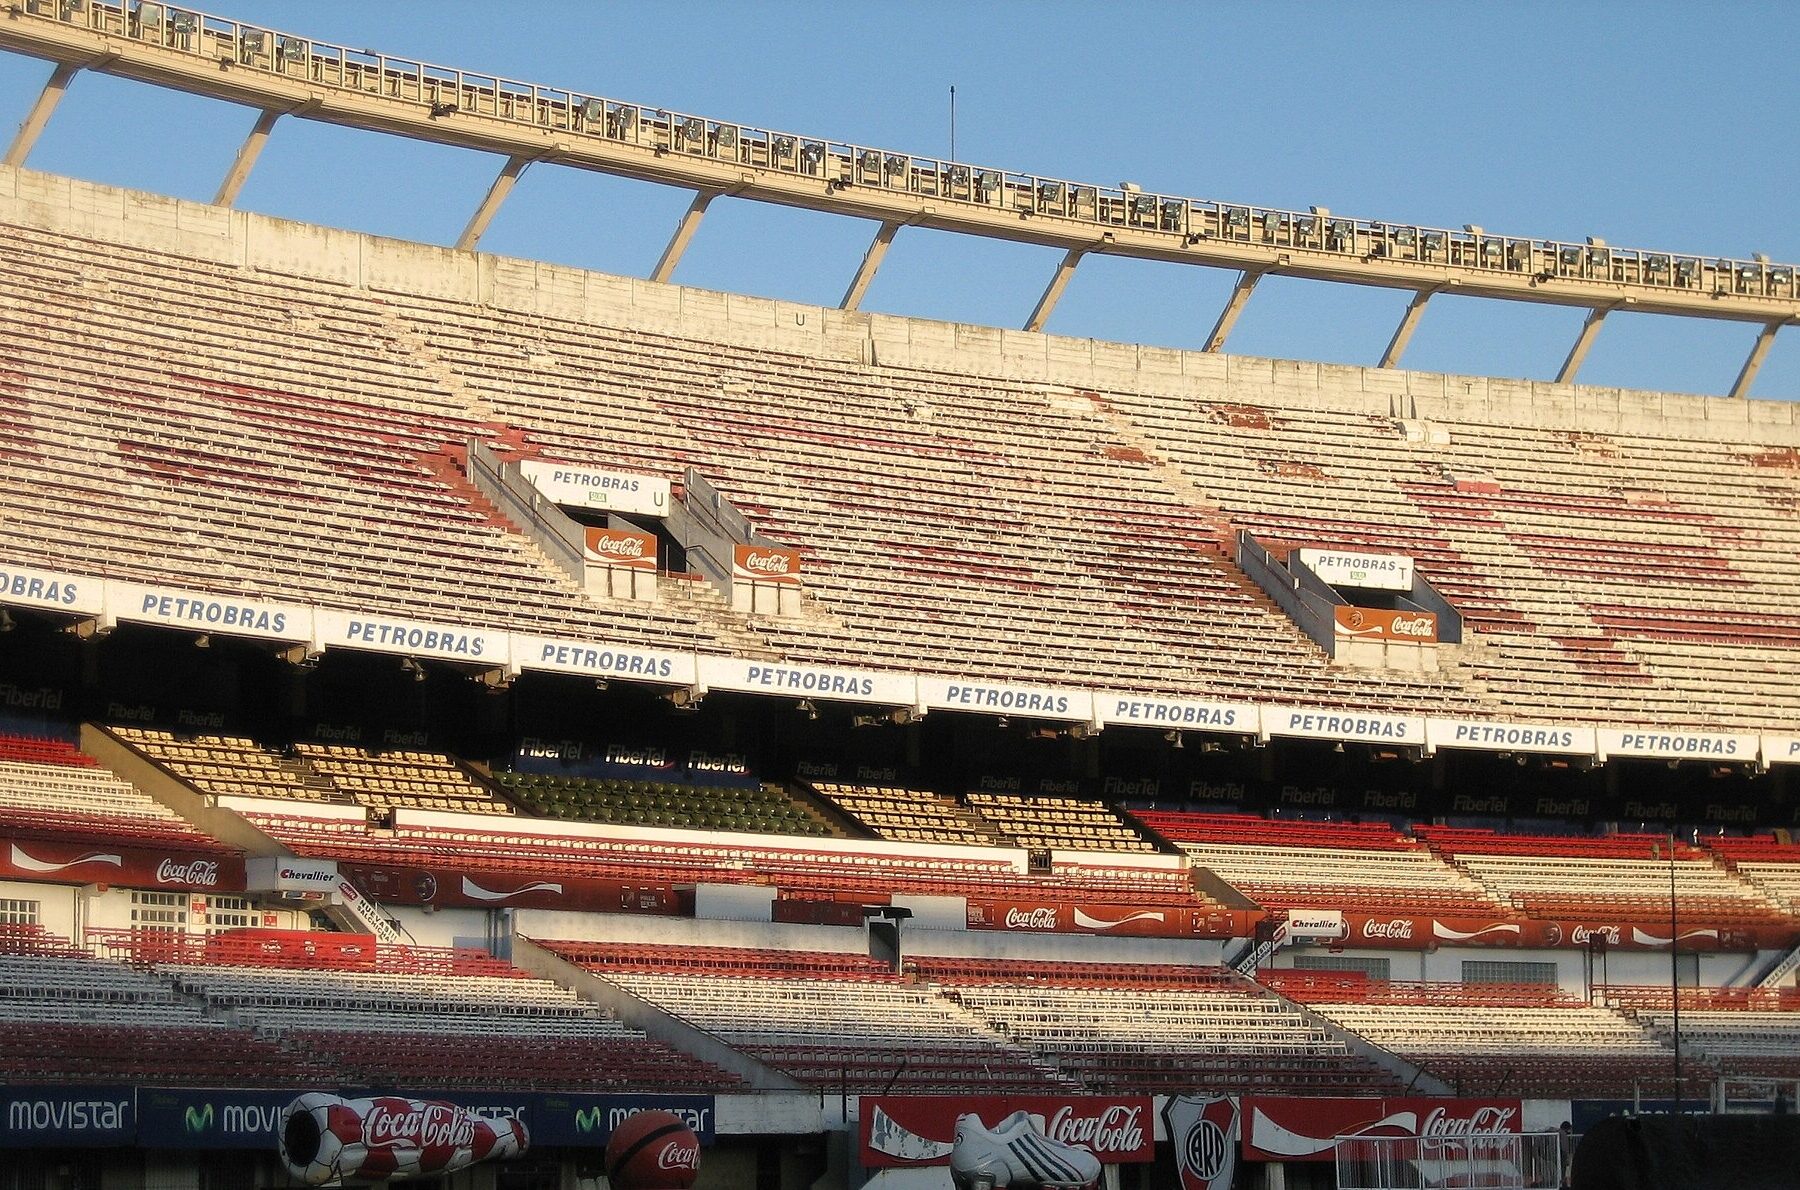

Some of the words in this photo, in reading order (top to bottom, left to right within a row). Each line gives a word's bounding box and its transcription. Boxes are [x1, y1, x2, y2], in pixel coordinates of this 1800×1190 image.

[795, 312, 805, 326] U
[553, 470, 640, 492] PETROBRAS
[653, 491, 664, 507] U
[597, 534, 645, 557] Coca-Cola
[745, 552, 791, 573] Coca-Cola
[1318, 555, 1397, 571] PETROBRAS
[1398, 567, 1408, 581] T
[142, 593, 287, 633] PETROBRAS
[1391, 616, 1434, 637] Coca-Cola
[347, 620, 485, 656] PETROBRAS
[541, 644, 673, 677] PETROBRAS
[746, 665, 874, 695] PETROBRAS
[946, 685, 1069, 713] PETROBRAS
[1115, 700, 1236, 726] PETROBRAS
[1289, 713, 1408, 738] PETROBRAS
[1455, 725, 1573, 747] PETROBRAS
[519, 737, 584, 760] FiberTel
[605, 743, 667, 767] FiberTel
[1621, 734, 1738, 754] PETROBRAS
[688, 750, 747, 773] FiberTel
[1104, 776, 1160, 797] FiberTel
[1189, 780, 1245, 801] FiberTel
[1280, 785, 1336, 805] FiberTel
[1363, 789, 1417, 809] FiberTel
[1536, 797, 1590, 815] FiberTel
[156, 857, 220, 886] Coca-Cola
[280, 868, 335, 882] Chevallier
[1005, 907, 1058, 929] Coca-Cola
[1291, 918, 1338, 929] Chevallier
[1363, 918, 1413, 939] Coca-Cola
[9, 1100, 129, 1130] movistar
[362, 1105, 475, 1150] Coca-Cola
[1046, 1105, 1144, 1152] Coca-Cola
